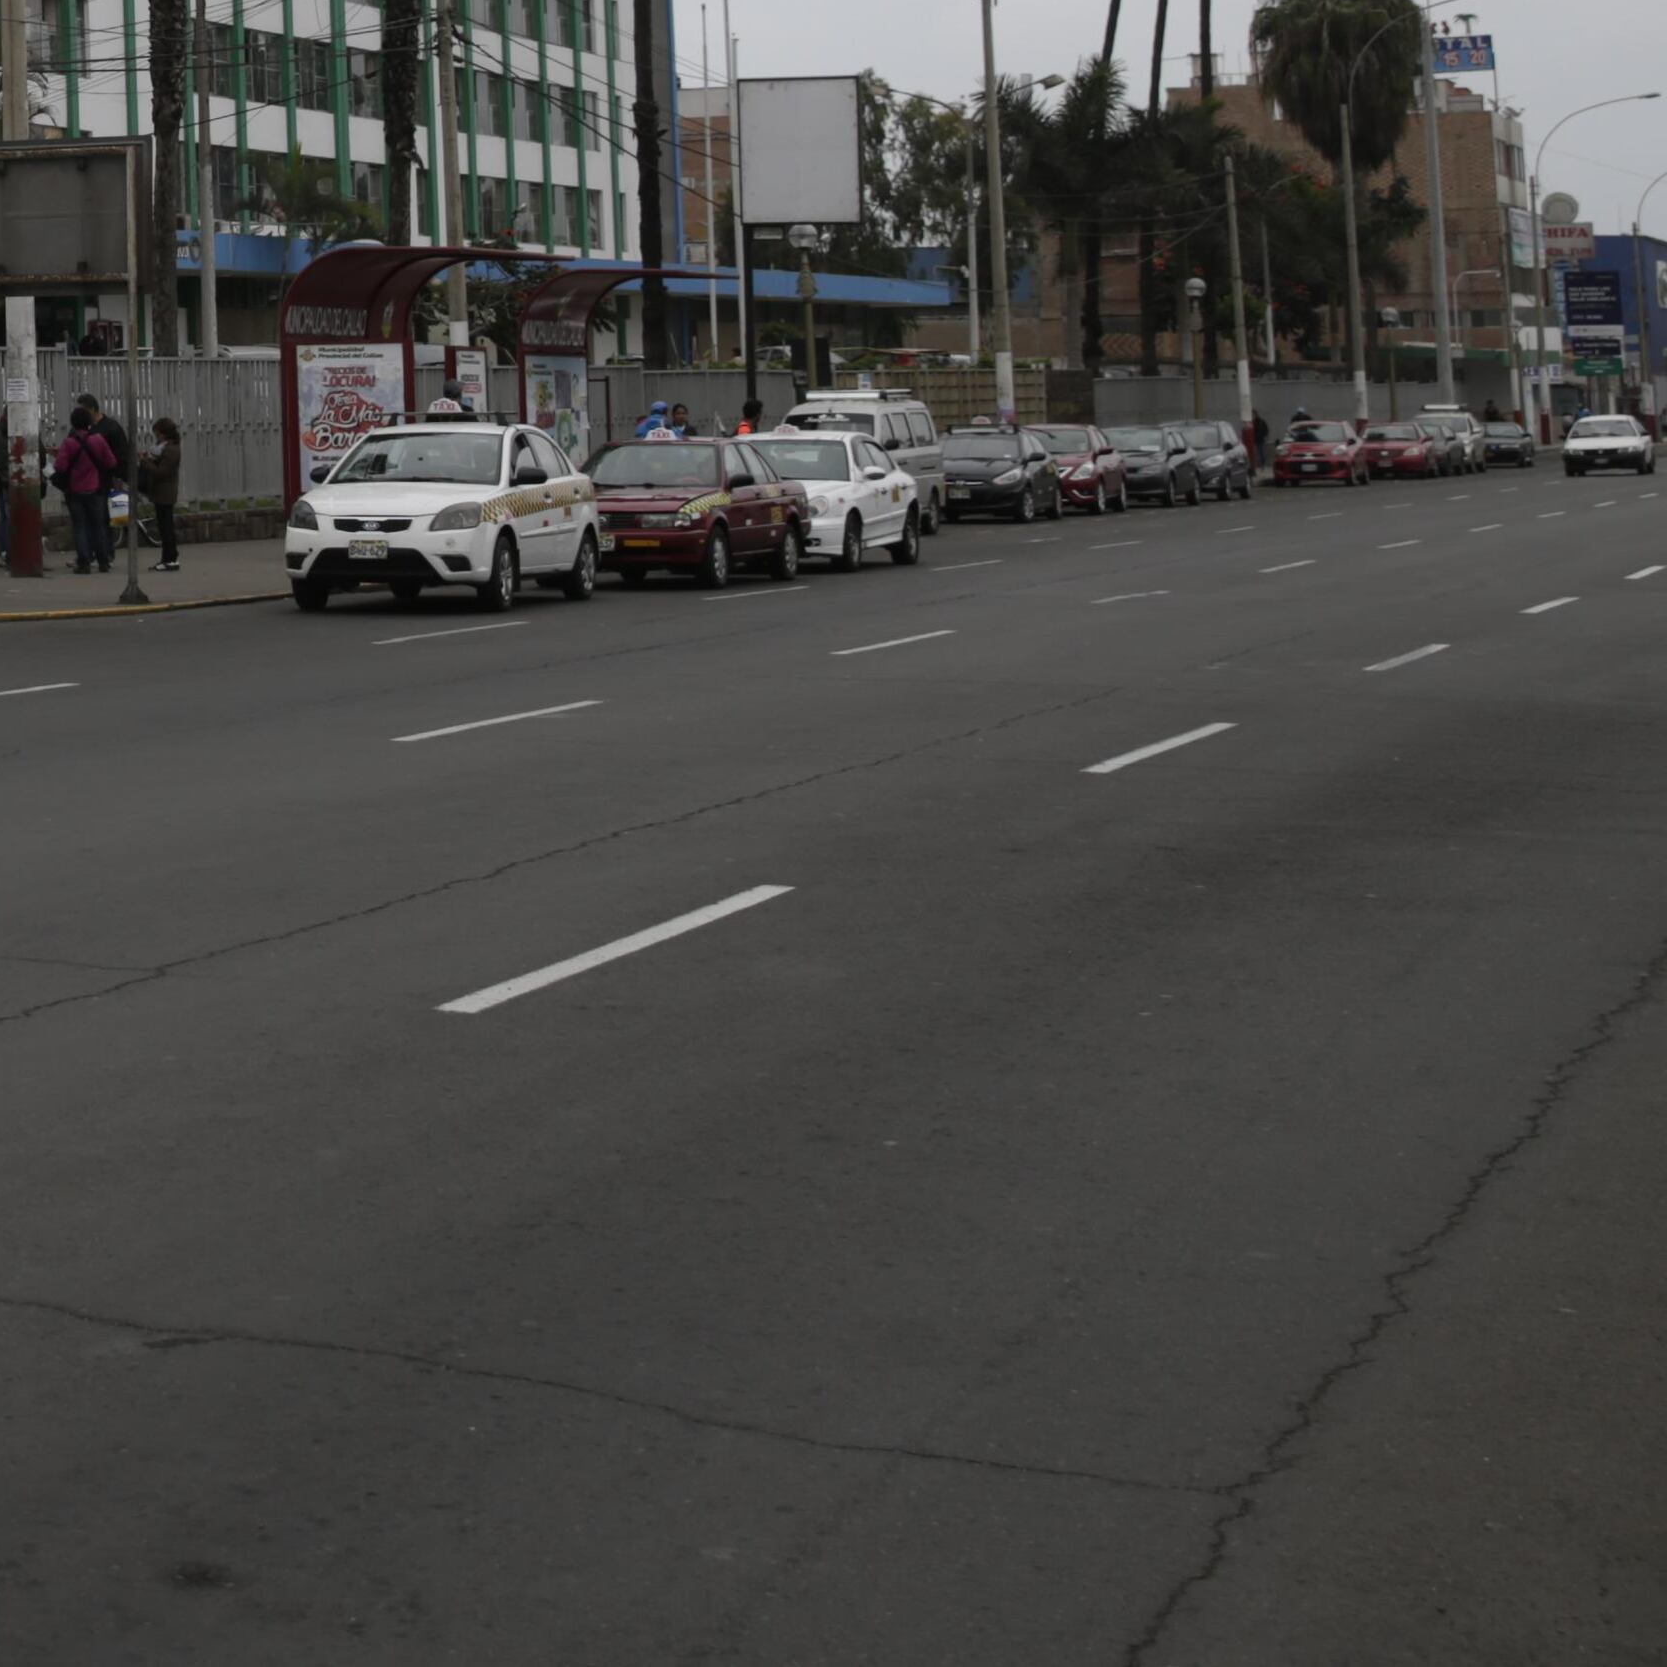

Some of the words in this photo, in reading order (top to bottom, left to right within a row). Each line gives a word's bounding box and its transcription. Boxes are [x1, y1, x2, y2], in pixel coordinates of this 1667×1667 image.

[1542, 227, 1589, 238] HIFA
[433, 403, 456, 411] TAXI
[307, 424, 367, 452] Bara
[651, 431, 671, 439] TAXI
